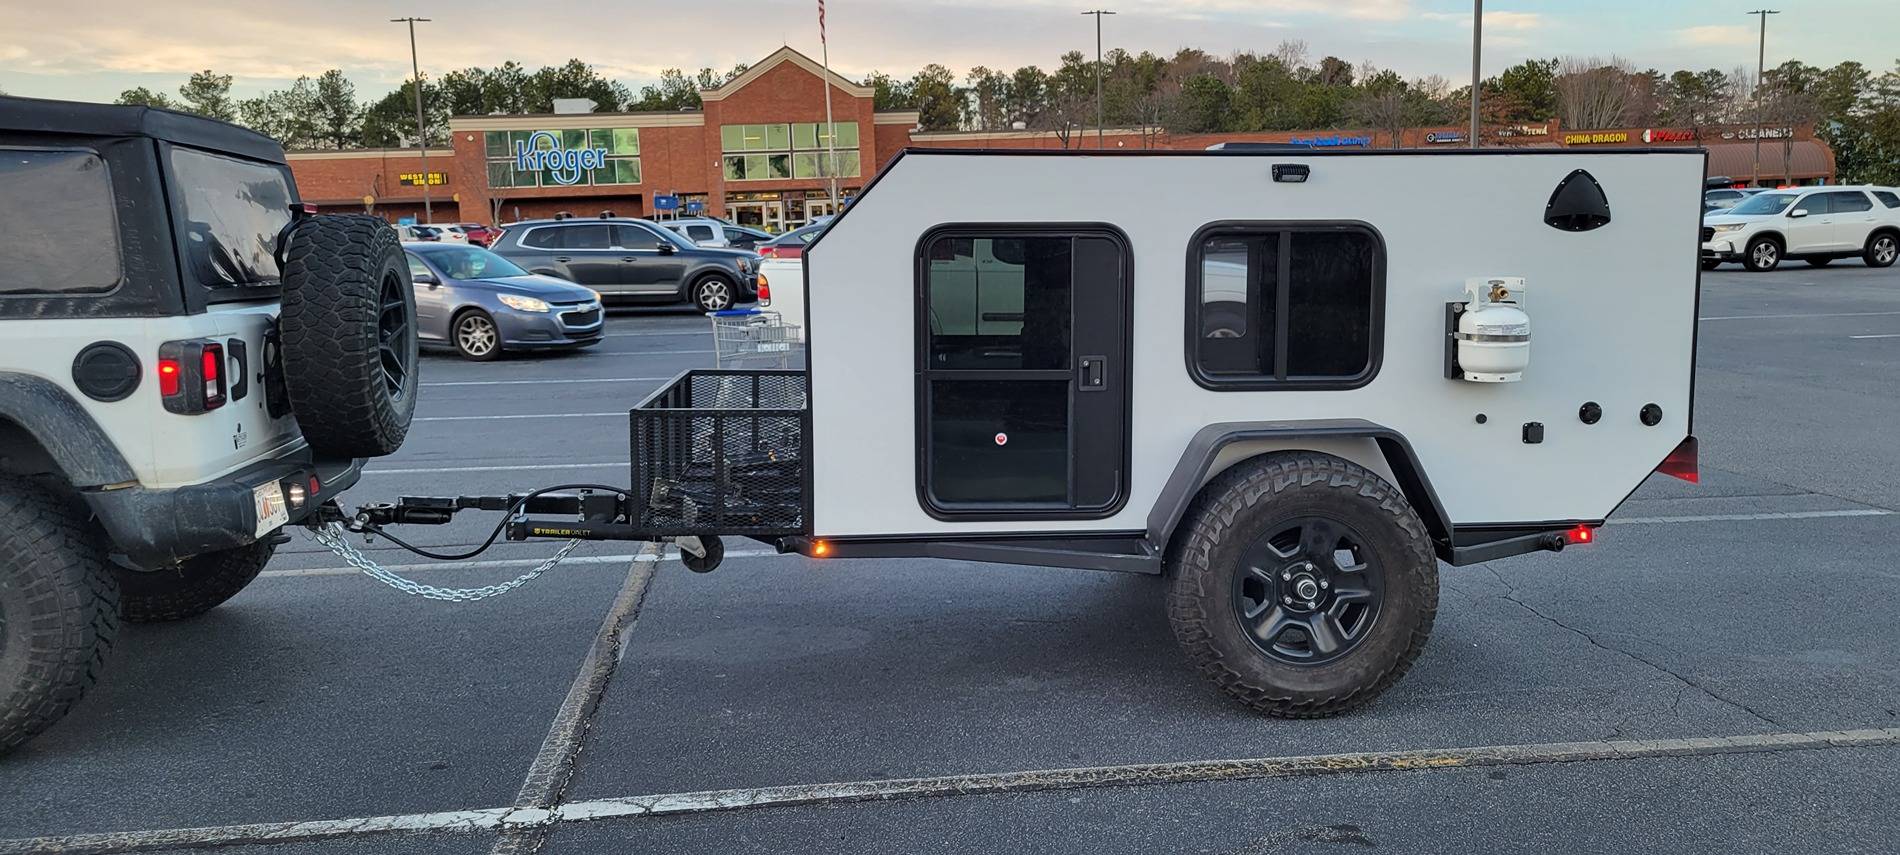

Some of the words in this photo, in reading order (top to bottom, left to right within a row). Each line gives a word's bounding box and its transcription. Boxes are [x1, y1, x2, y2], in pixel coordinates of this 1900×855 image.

[1565, 135, 1591, 144] CHINA
[1592, 133, 1627, 143] DRAGON
[516, 130, 607, 185] Kroger
[541, 528, 571, 536] TRAILER
